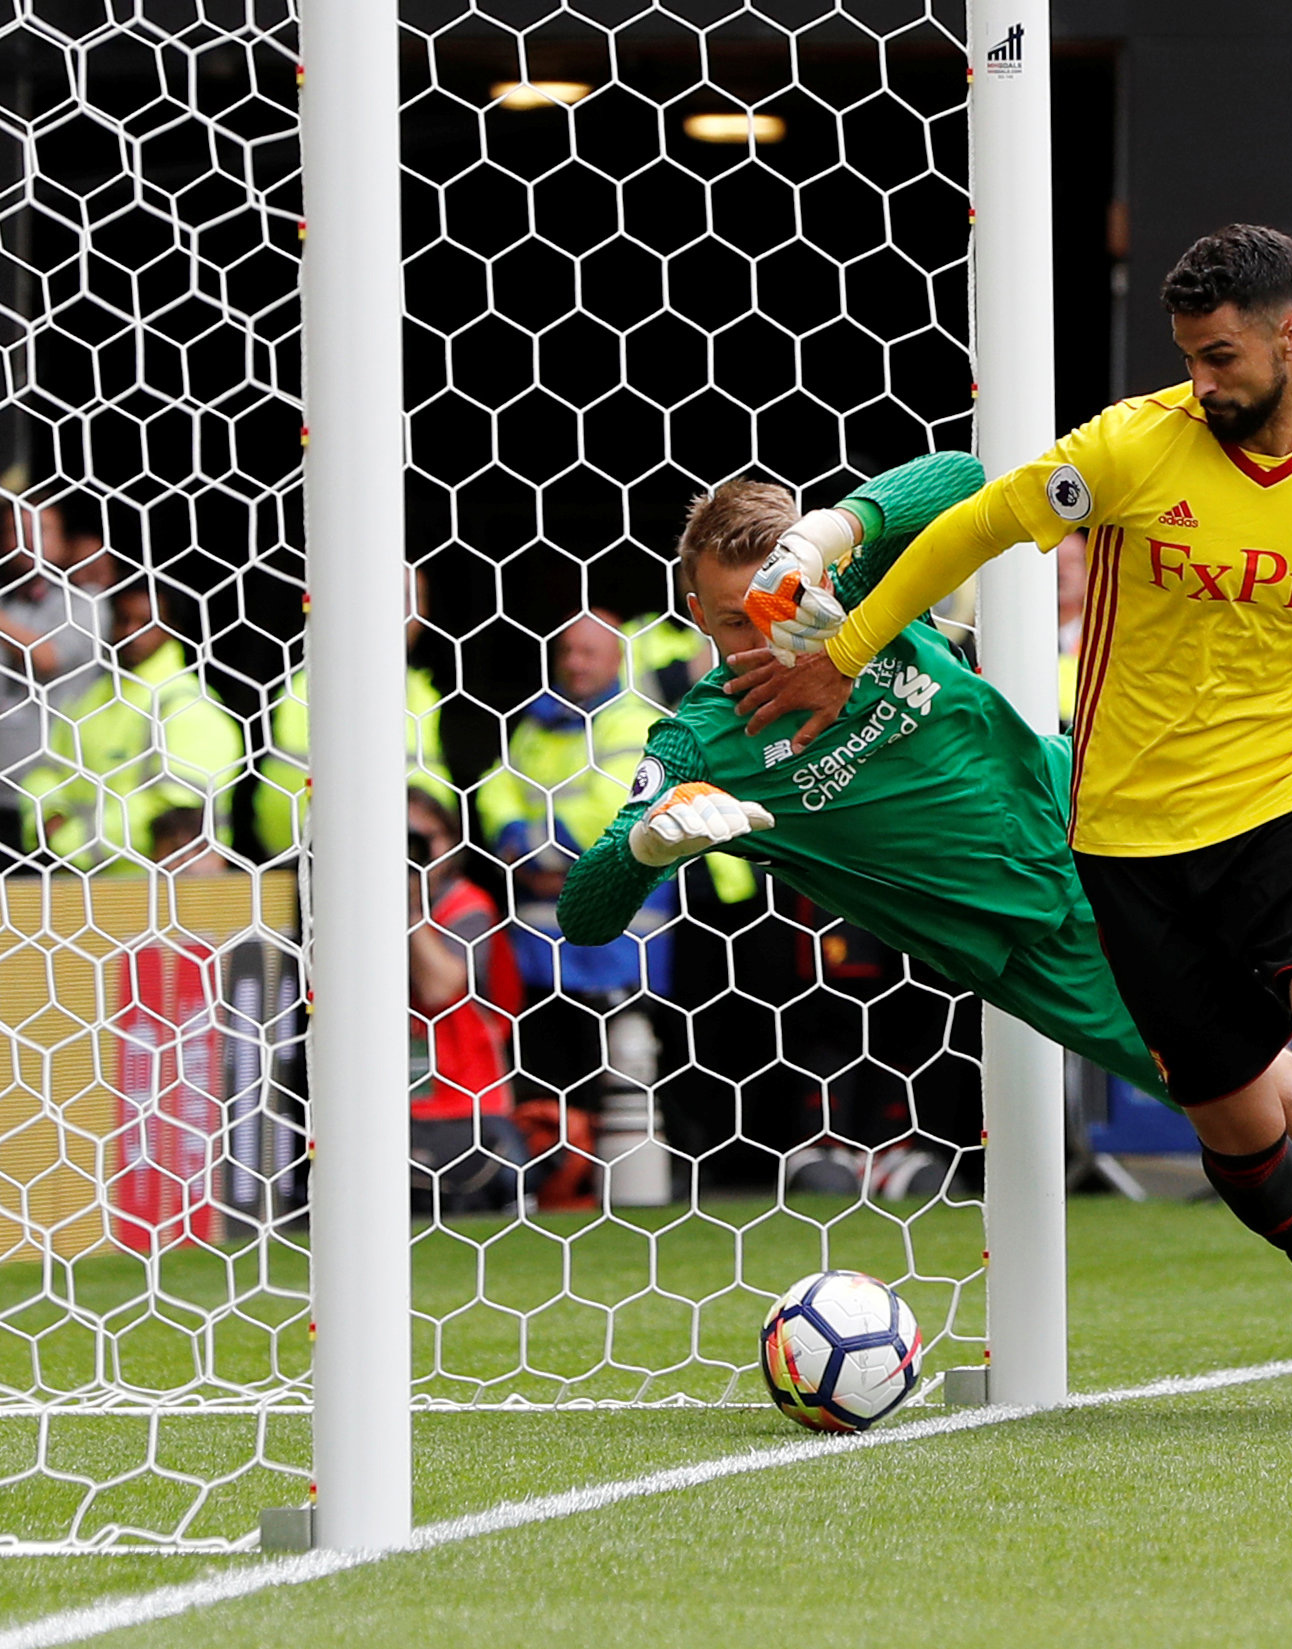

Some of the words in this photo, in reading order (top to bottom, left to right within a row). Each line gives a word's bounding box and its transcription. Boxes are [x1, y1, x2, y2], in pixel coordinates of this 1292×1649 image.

[1158, 515, 1199, 528] adidas
[878, 657, 897, 688] LFC
[792, 699, 897, 790] Standard
